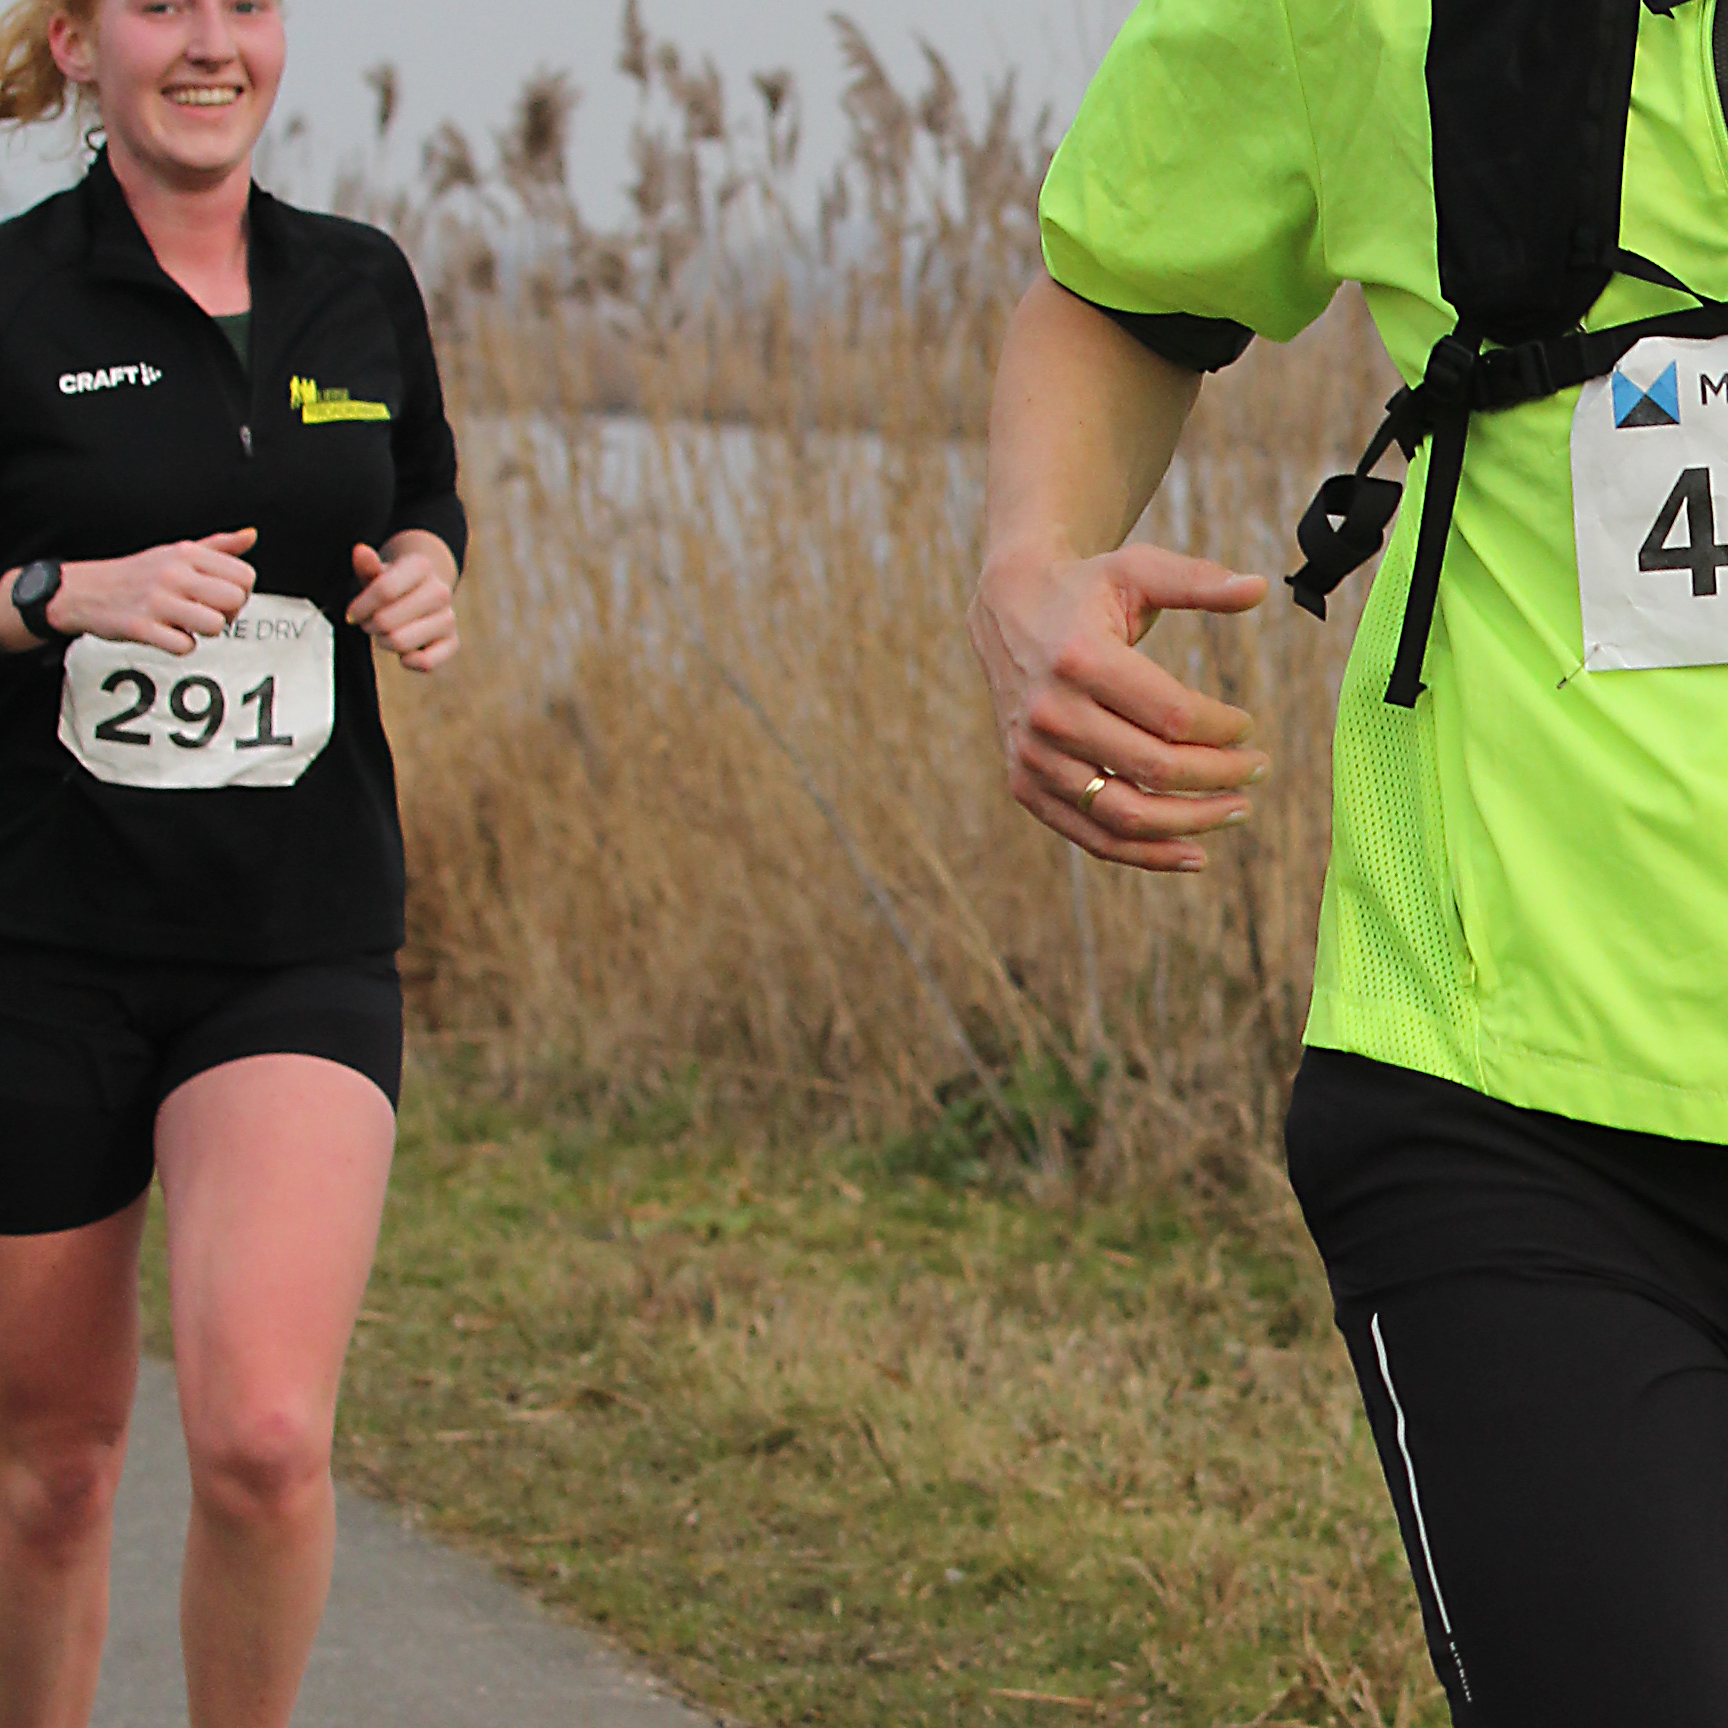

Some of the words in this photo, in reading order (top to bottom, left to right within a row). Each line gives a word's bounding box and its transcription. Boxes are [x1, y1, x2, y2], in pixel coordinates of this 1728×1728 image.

[59, 365, 139, 394] CRAFT
[256, 618, 308, 641] DRV
[94, 669, 295, 751] 291
